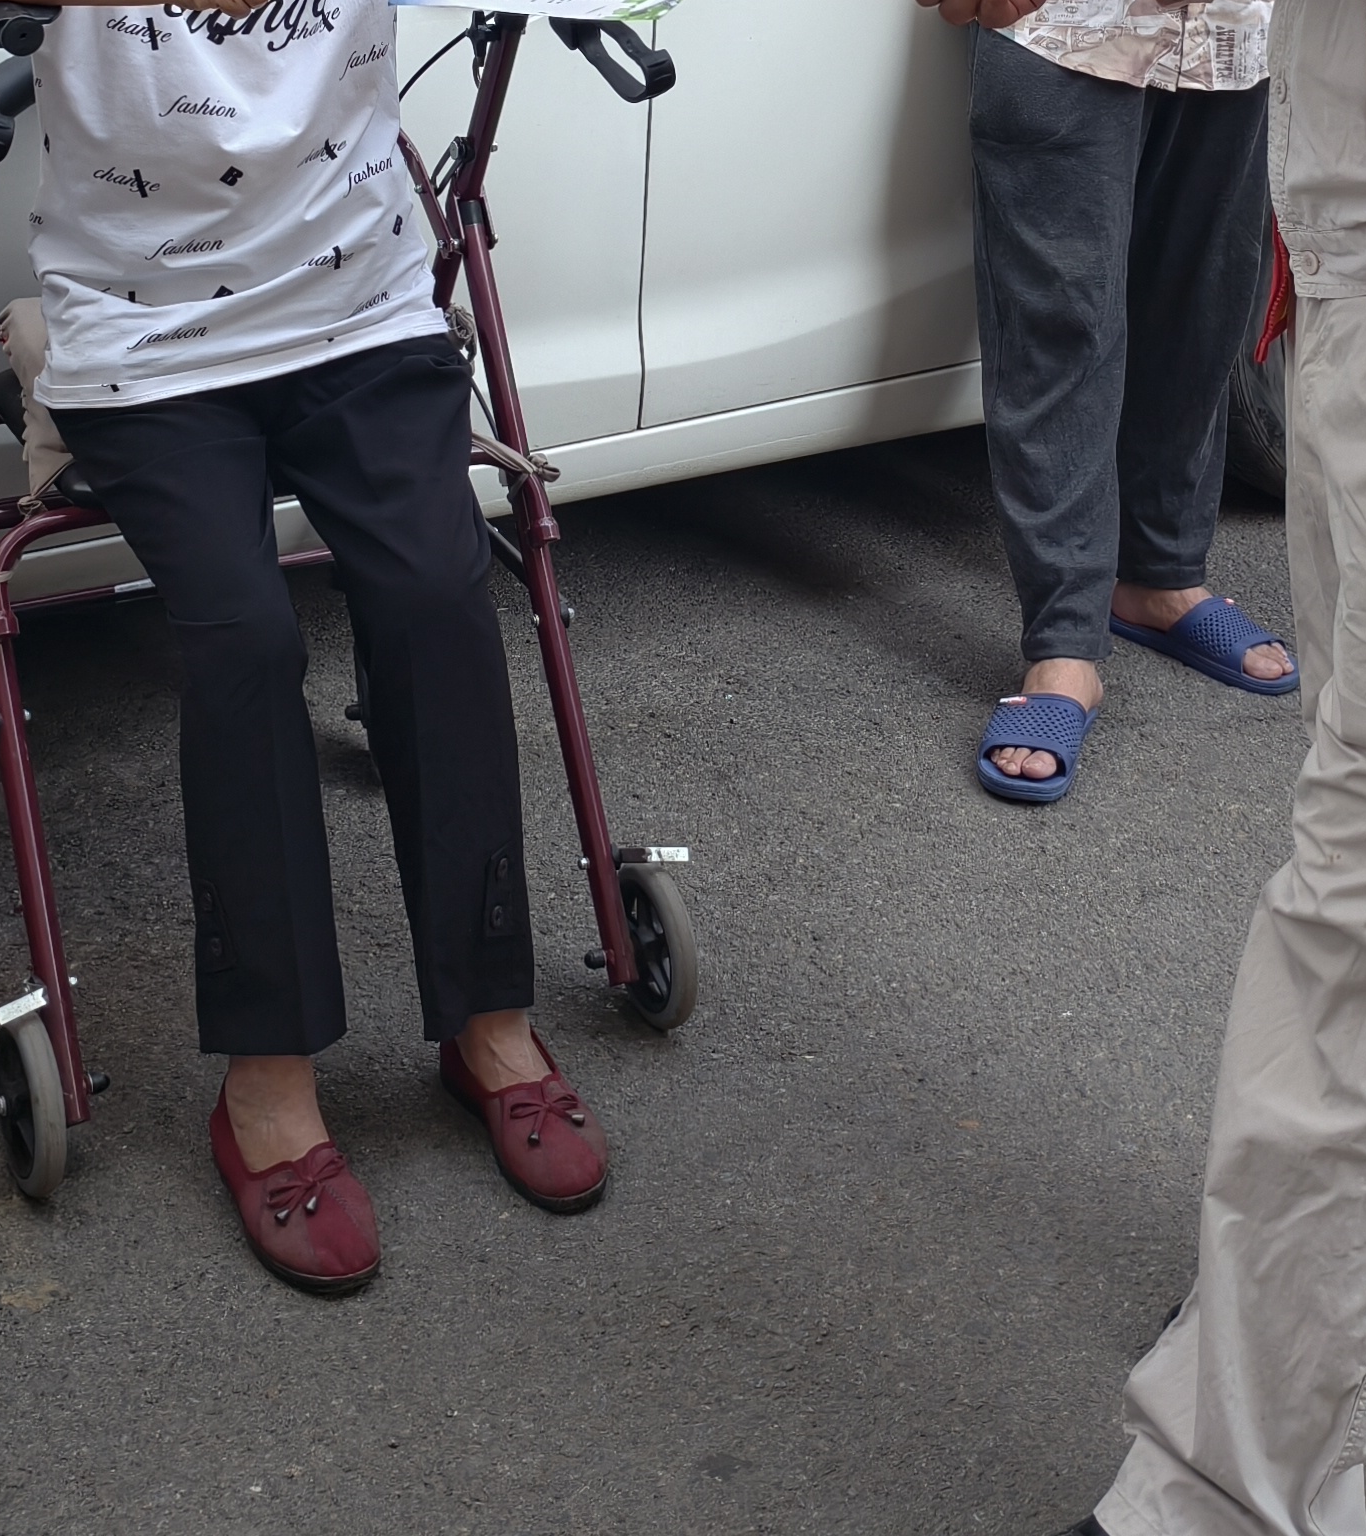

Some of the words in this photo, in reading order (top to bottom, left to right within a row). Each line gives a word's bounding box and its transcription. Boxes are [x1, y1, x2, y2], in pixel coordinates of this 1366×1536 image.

[158, 94, 238, 119] fashion
[219, 165, 245, 188] B
[343, 157, 393, 199] fashion
[391, 214, 404, 236] B
[145, 238, 225, 261] fashion
[126, 324, 210, 351] fashion
